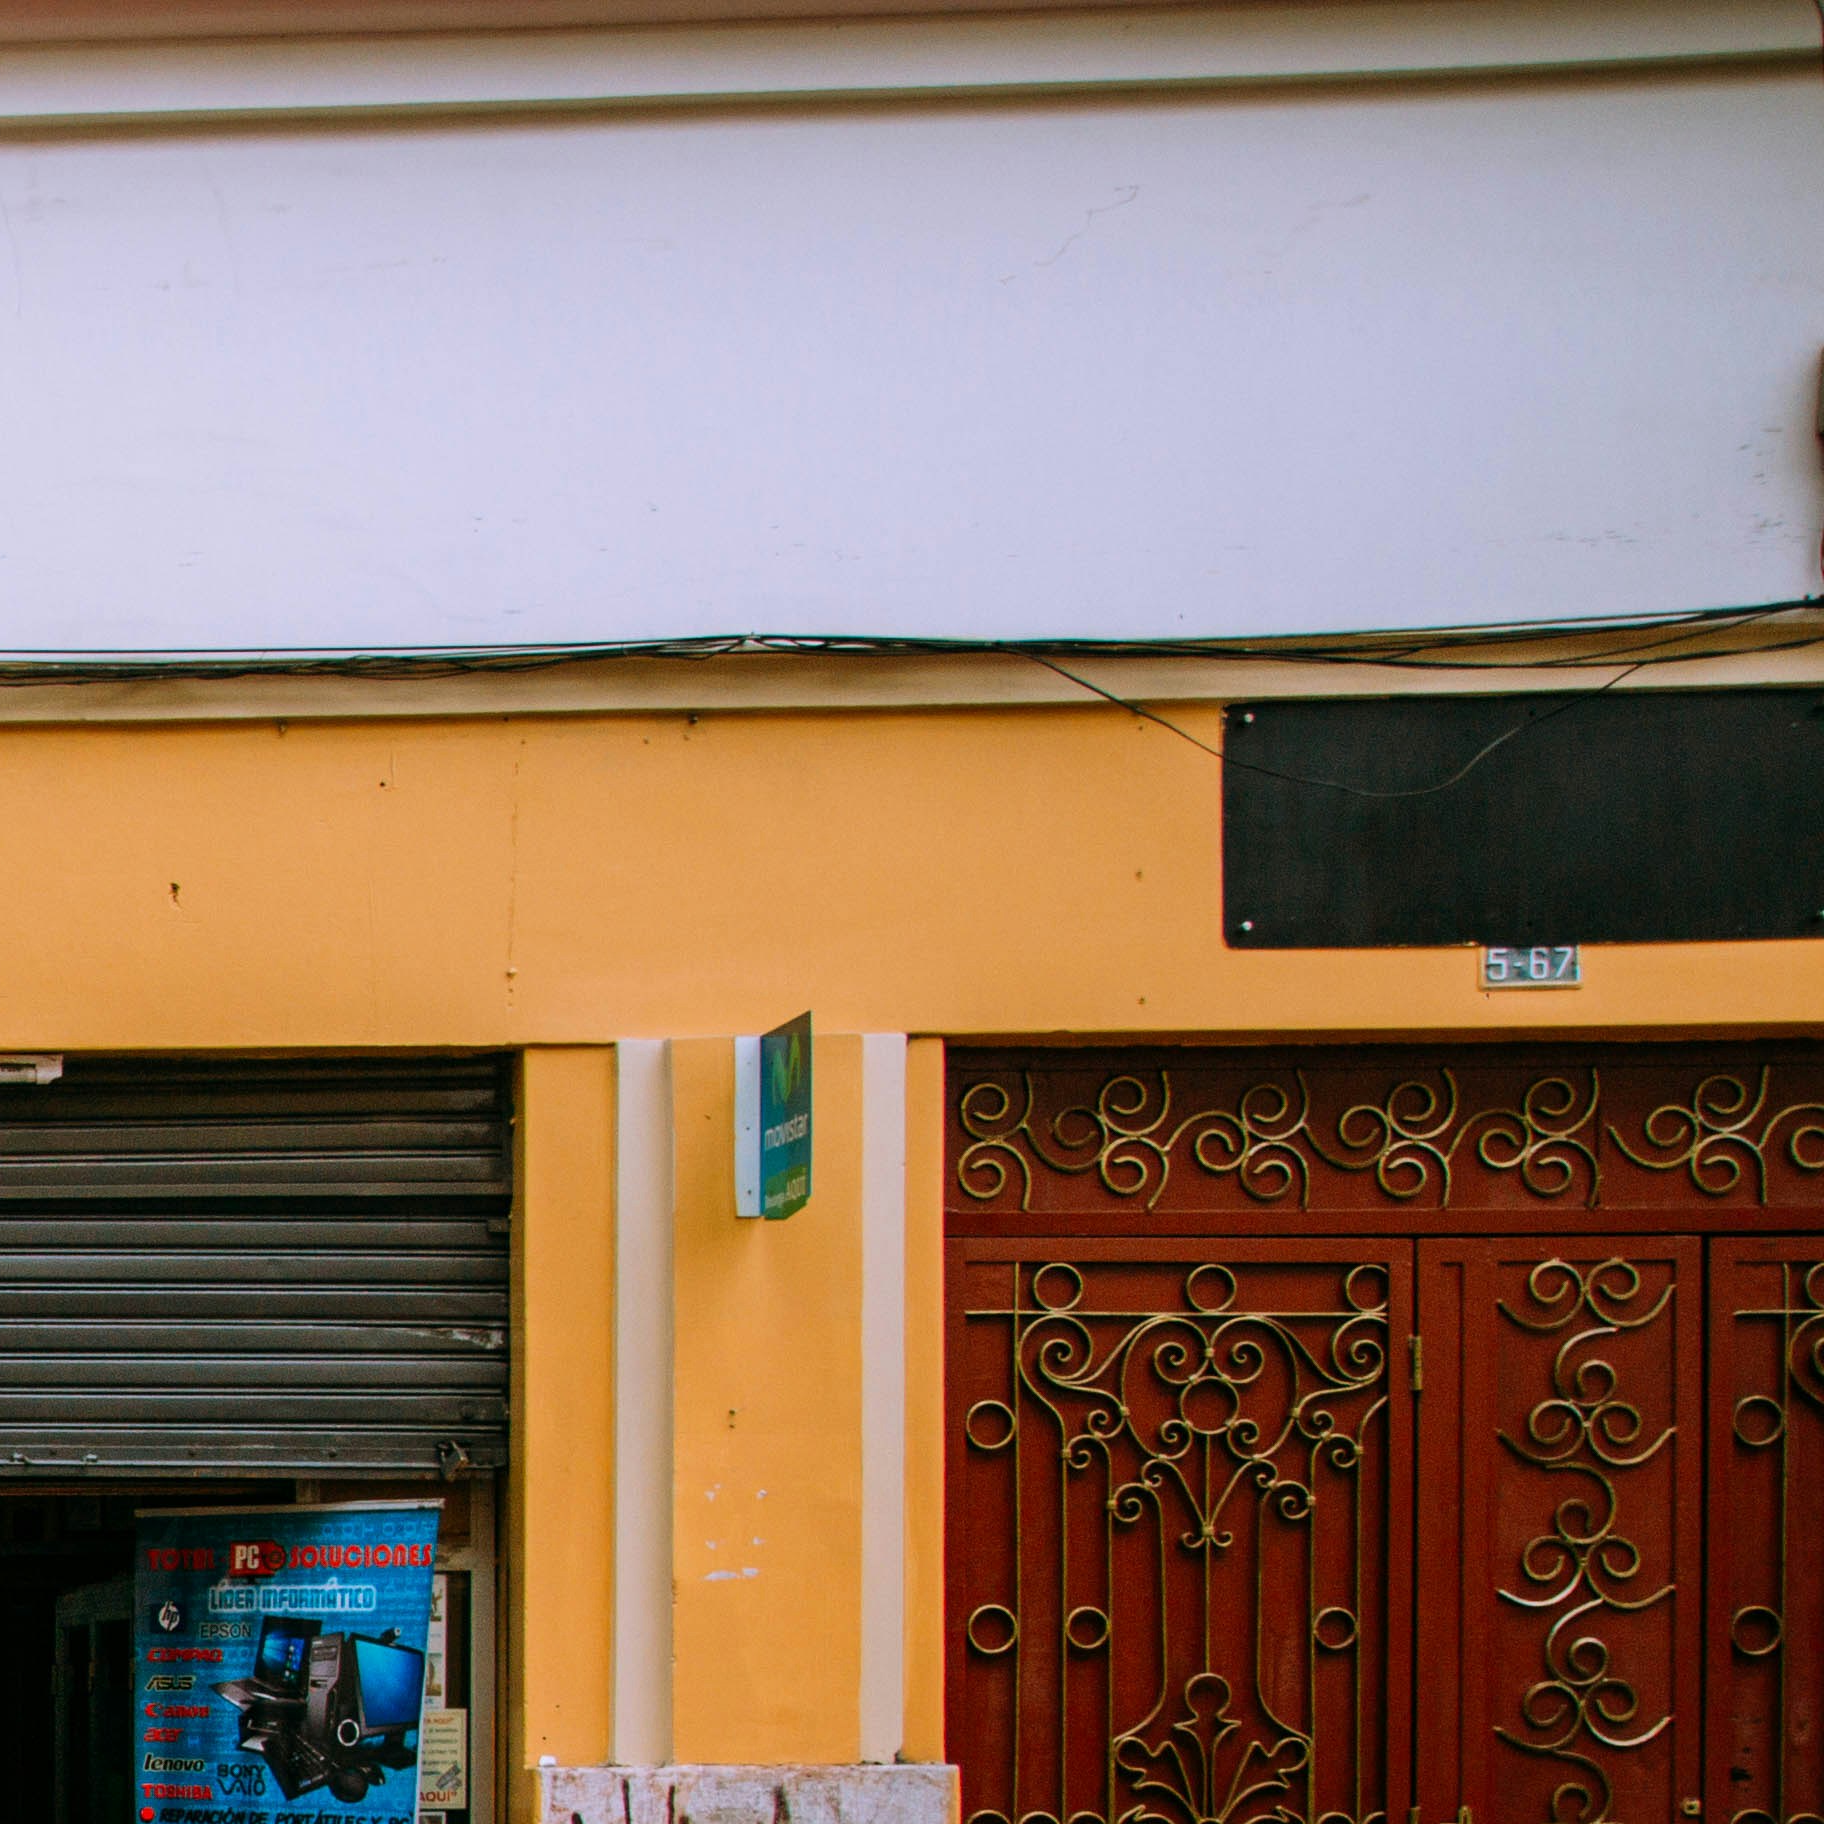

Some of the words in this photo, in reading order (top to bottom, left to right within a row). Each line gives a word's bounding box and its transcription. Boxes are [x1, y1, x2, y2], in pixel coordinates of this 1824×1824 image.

[1487, 948, 1574, 980] 5-67
[234, 1544, 260, 1570] PC
[288, 1544, 432, 1569] SOLUCIONES
[200, 1624, 252, 1638] EPSON
[145, 1675, 196, 1691] ASUS
[143, 1727, 184, 1742] acer
[143, 1752, 205, 1772] lenovo
[217, 1764, 265, 1778] SONY
[141, 1783, 213, 1800] TOSHIBA
